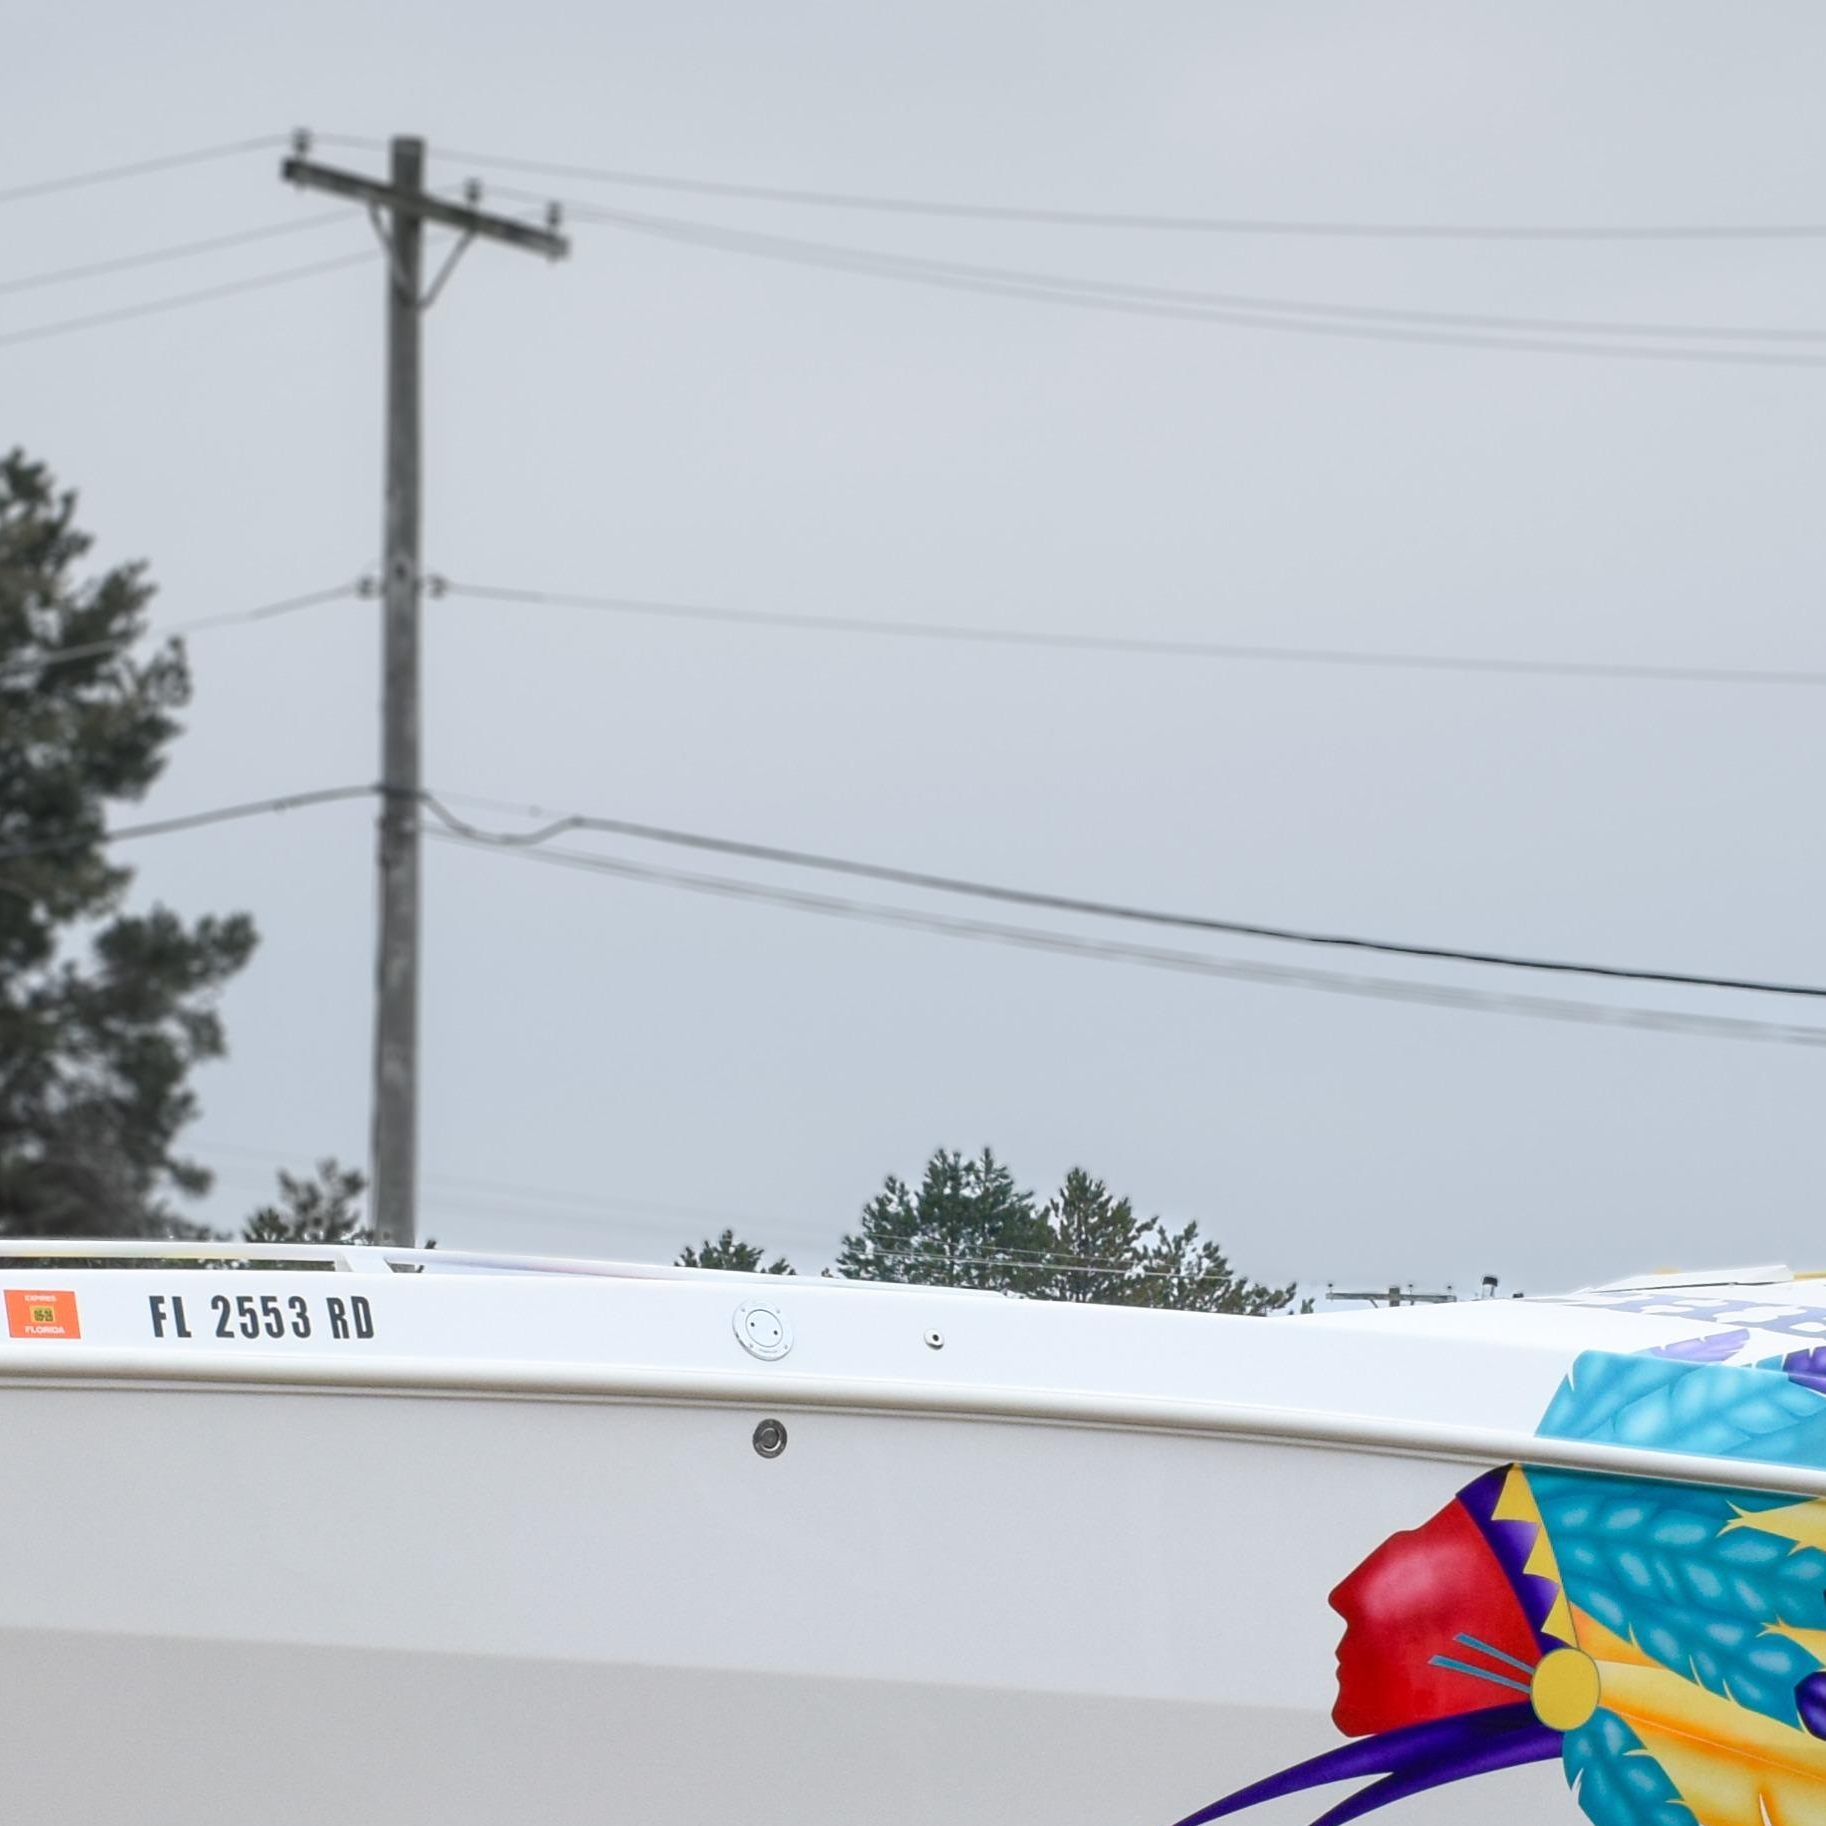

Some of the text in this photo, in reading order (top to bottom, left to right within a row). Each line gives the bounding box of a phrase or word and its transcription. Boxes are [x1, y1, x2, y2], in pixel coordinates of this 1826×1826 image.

[24, 1325, 66, 1334] FLORIDA
[148, 1294, 374, 1339] FL 2553 RD
